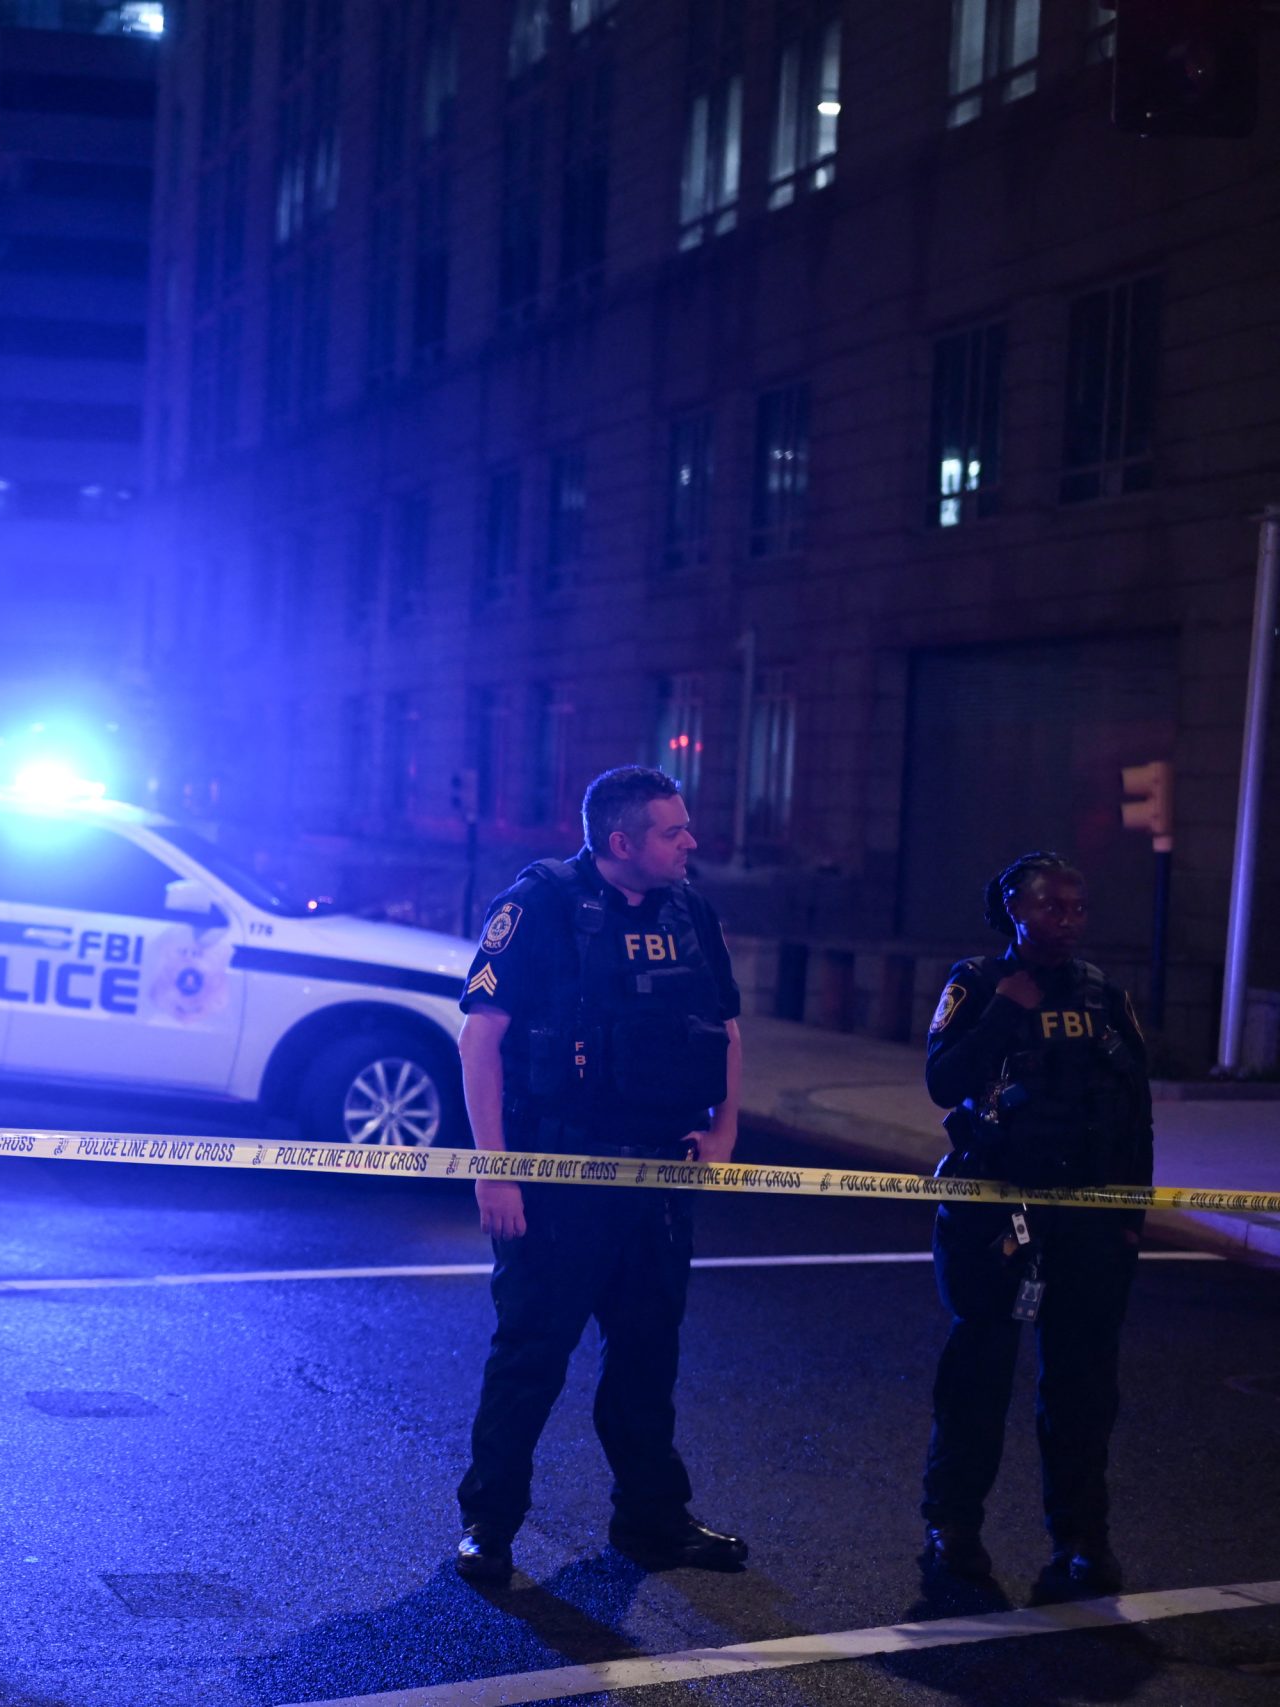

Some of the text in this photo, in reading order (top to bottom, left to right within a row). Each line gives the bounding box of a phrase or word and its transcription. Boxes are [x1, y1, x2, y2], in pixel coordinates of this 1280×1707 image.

[78, 930, 145, 965] FBI
[624, 934, 677, 961] FBI
[1040, 1011, 1094, 1039] FBI
[77, 1137, 119, 1156] POLICE
[120, 1140, 148, 1158] LINE
[149, 1141, 167, 1159] DO
[169, 1141, 194, 1160] NOT
[195, 1142, 235, 1162] CROSS
[275, 1147, 317, 1165] POLICE
[317, 1149, 346, 1167] LINE
[345, 1150, 363, 1168] DO
[364, 1151, 390, 1170] NOT
[390, 1152, 429, 1171] CROSS
[468, 1155, 509, 1174] POLICE
[510, 1157, 537, 1176] LINE
[537, 1159, 555, 1177] DO
[556, 1160, 581, 1179] NOT
[581, 1162, 619, 1180] CROSS
[656, 1164, 697, 1184] POLICE
[697, 1167, 722, 1185] LINE
[723, 1169, 741, 1186] DO
[742, 1169, 765, 1187] NOT
[765, 1171, 803, 1188] CROSS
[840, 1174, 879, 1192] POLICE
[880, 1177, 902, 1193] LINE
[905, 1178, 921, 1193] DO
[922, 1179, 945, 1194] NOT
[946, 1181, 981, 1196] CROSS
